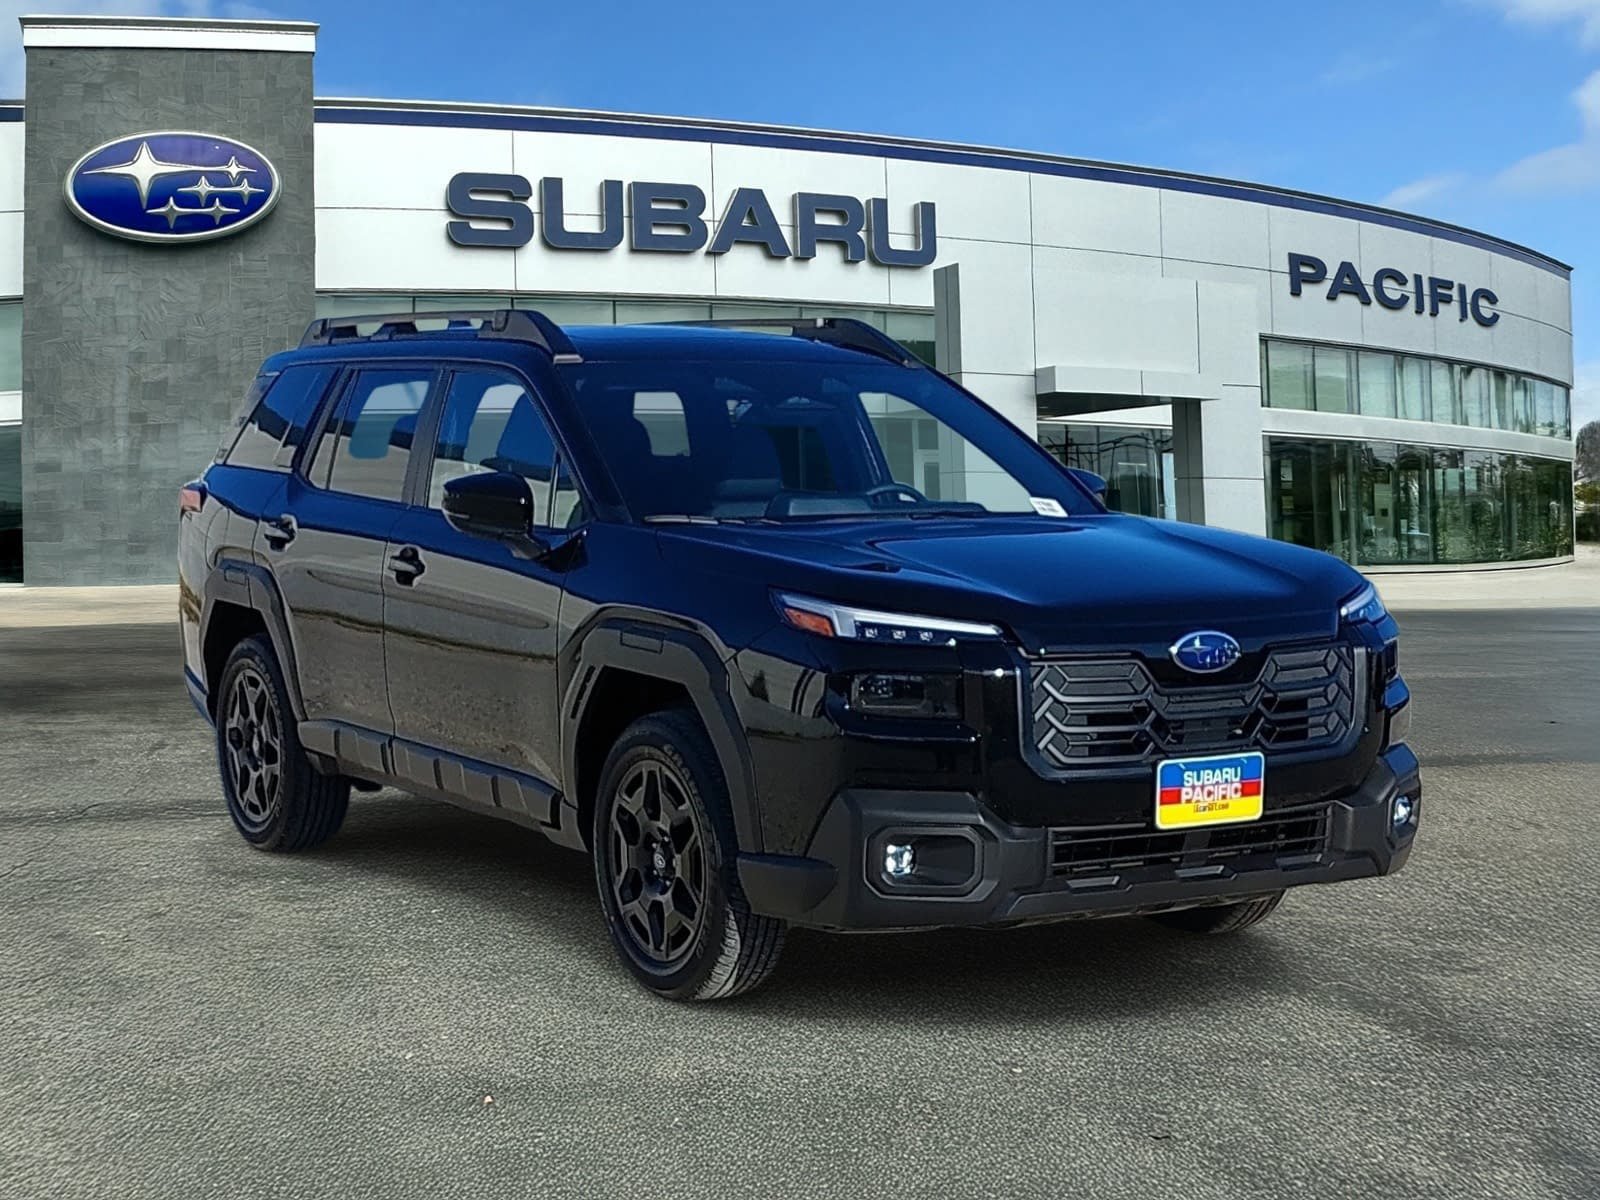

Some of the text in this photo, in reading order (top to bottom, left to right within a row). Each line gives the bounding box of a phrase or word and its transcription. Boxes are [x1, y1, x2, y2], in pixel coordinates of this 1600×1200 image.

[446, 171, 937, 268] SUBARU
[1287, 251, 1500, 327] PACIFIC
[1181, 782, 1243, 804] PACIFIC
[1183, 766, 1242, 787] SUBARU
